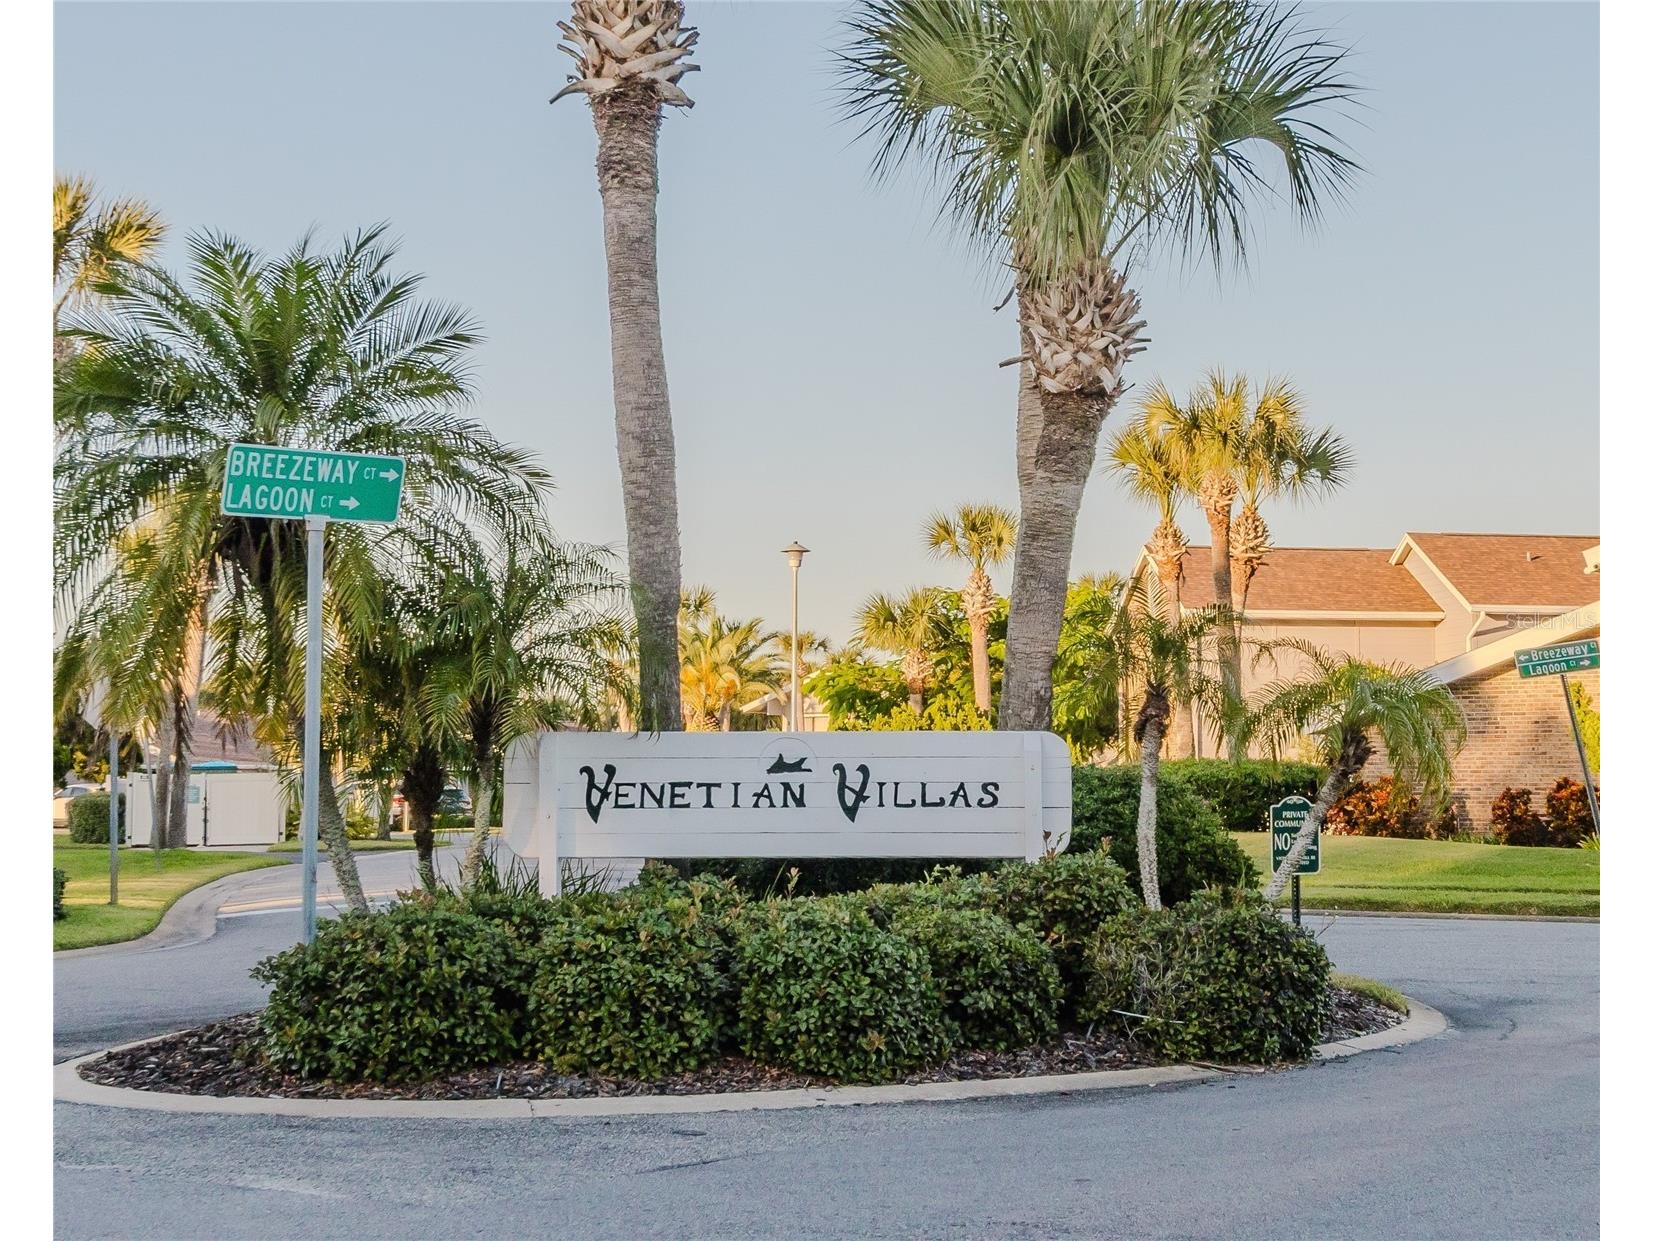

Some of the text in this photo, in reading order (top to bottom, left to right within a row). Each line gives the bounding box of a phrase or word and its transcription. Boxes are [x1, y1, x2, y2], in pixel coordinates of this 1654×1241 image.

[231, 451, 376, 484] BREEZEWAY CT
[226, 483, 333, 512] LAGOON CT
[1531, 644, 1588, 661] Breezeway
[1529, 661, 1567, 676] Lagoon
[580, 763, 1000, 824] VENETIAN VILLAS
[1274, 833, 1291, 850] NO
